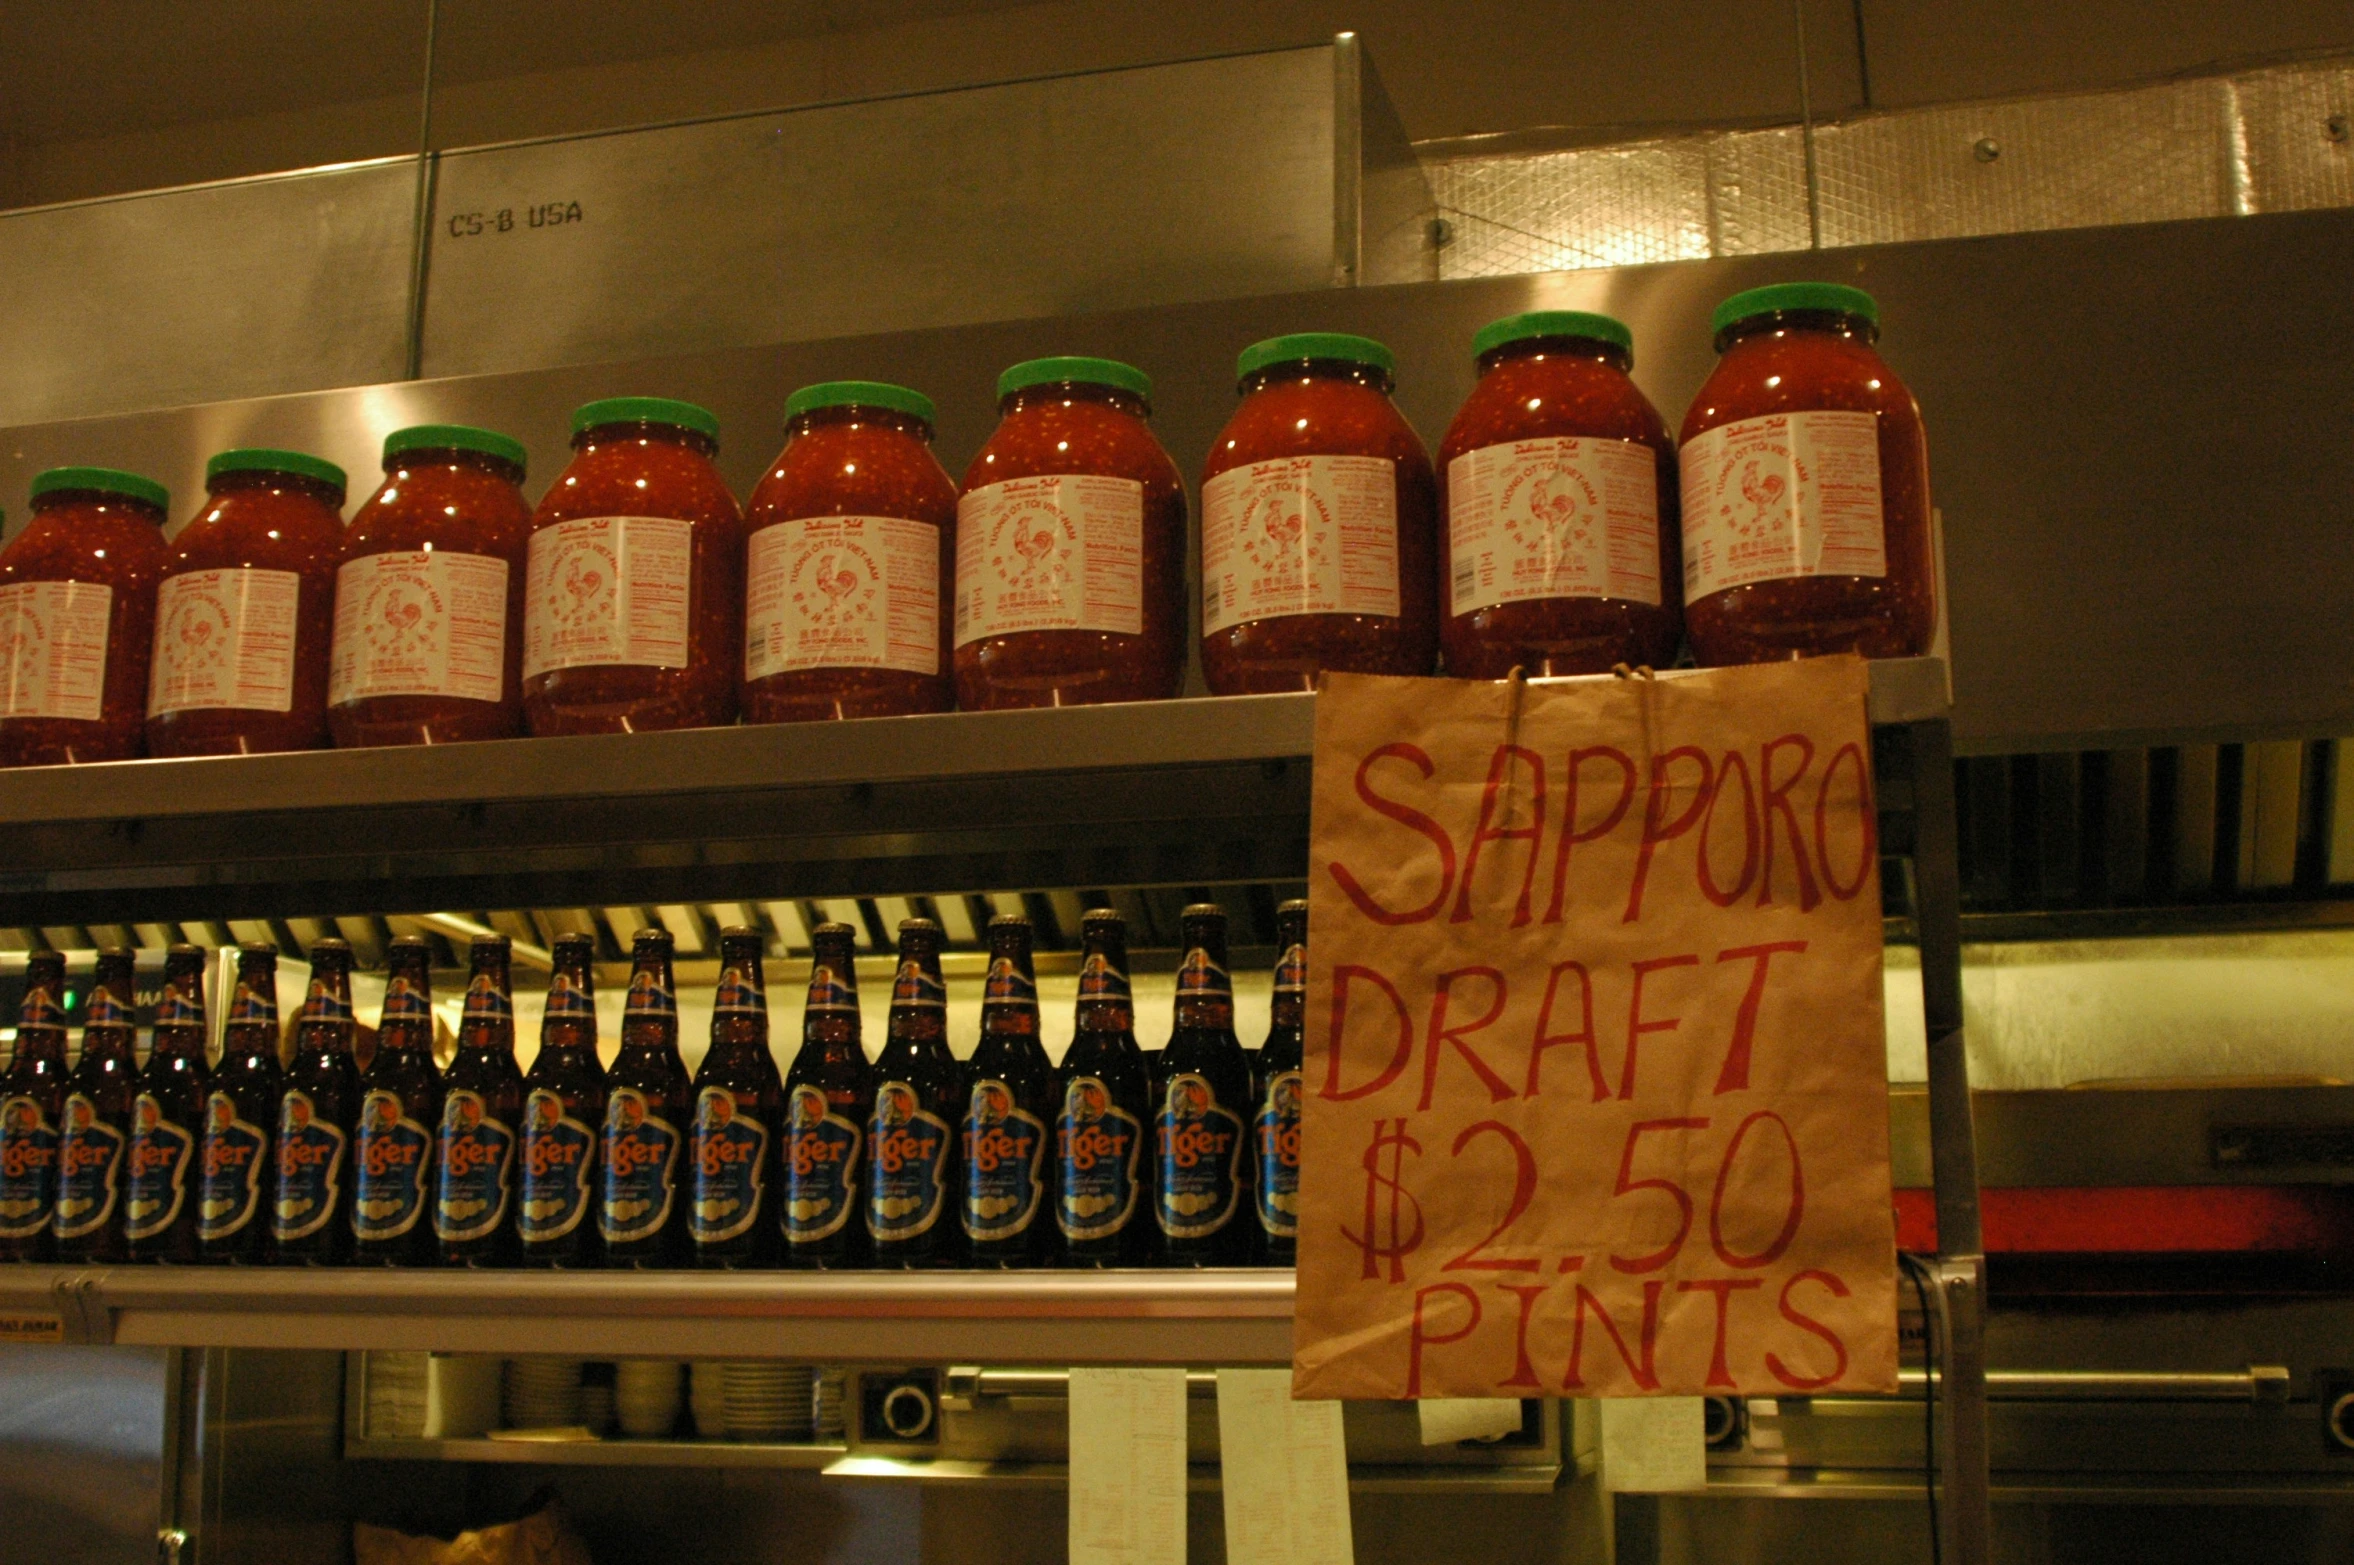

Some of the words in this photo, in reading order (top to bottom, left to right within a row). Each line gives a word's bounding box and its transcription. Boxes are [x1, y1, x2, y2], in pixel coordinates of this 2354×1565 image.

[528, 200, 583, 228] USA
[1328, 733, 1875, 929] SAPPORO
[1317, 940, 1809, 1113] DRAFT
[867, 1128, 937, 1173] Tiger
[962, 1127, 1033, 1172] Tiger
[1057, 1125, 1130, 1171] Tiger
[1157, 1122, 1232, 1168] Tiger
[1258, 1121, 1301, 1168] Tig
[1339, 1109, 1806, 1284] $2.50
[1405, 1269, 1853, 1400] PINTS
